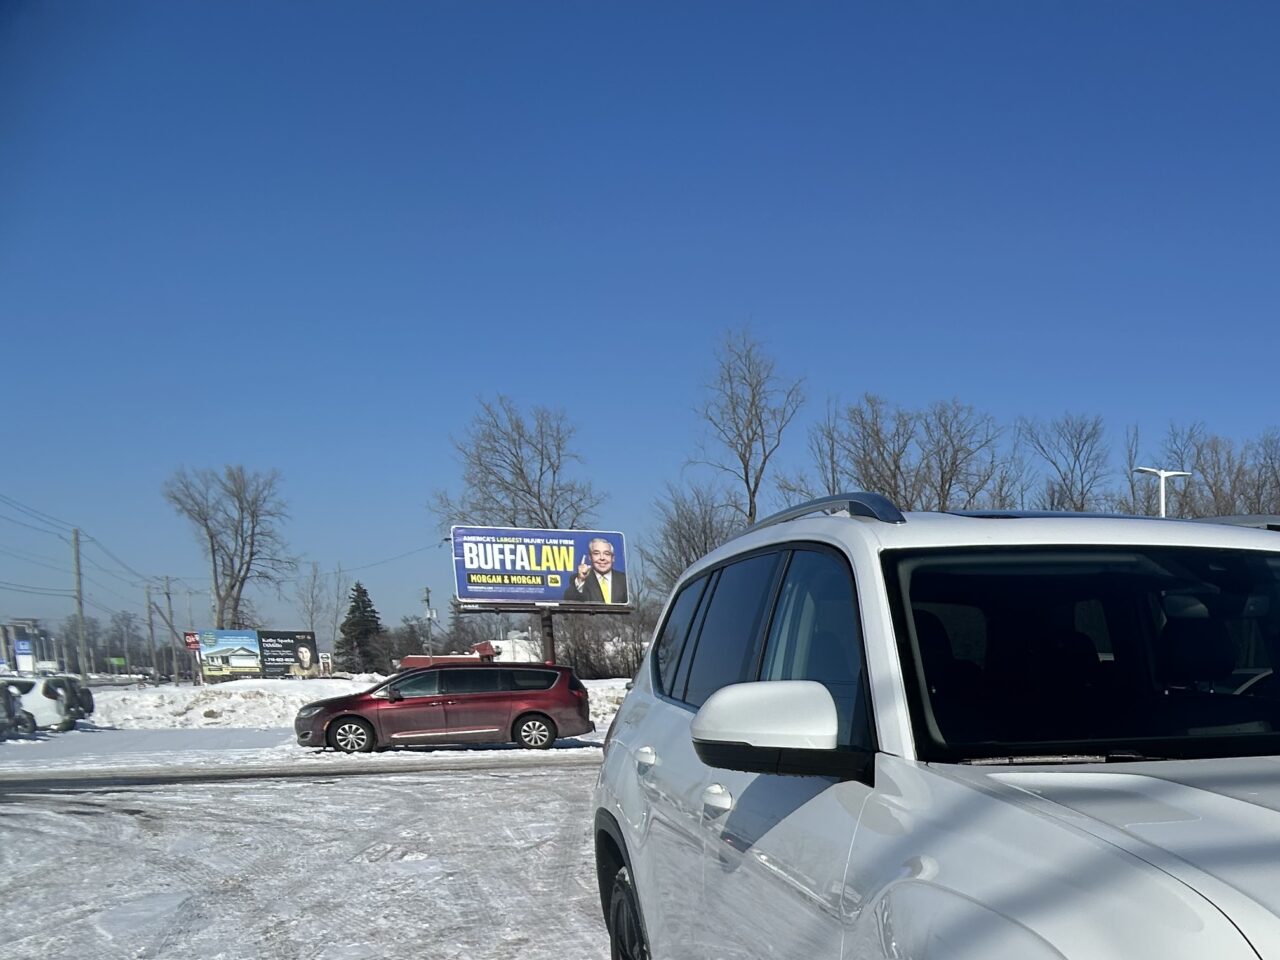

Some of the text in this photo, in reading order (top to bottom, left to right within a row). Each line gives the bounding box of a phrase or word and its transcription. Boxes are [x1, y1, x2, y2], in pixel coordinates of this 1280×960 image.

[463, 542, 575, 571] BUFFALAW
[470, 574, 503, 584] MORGAN
[504, 575, 510, 584] &
[511, 575, 542, 585] MORGAN
